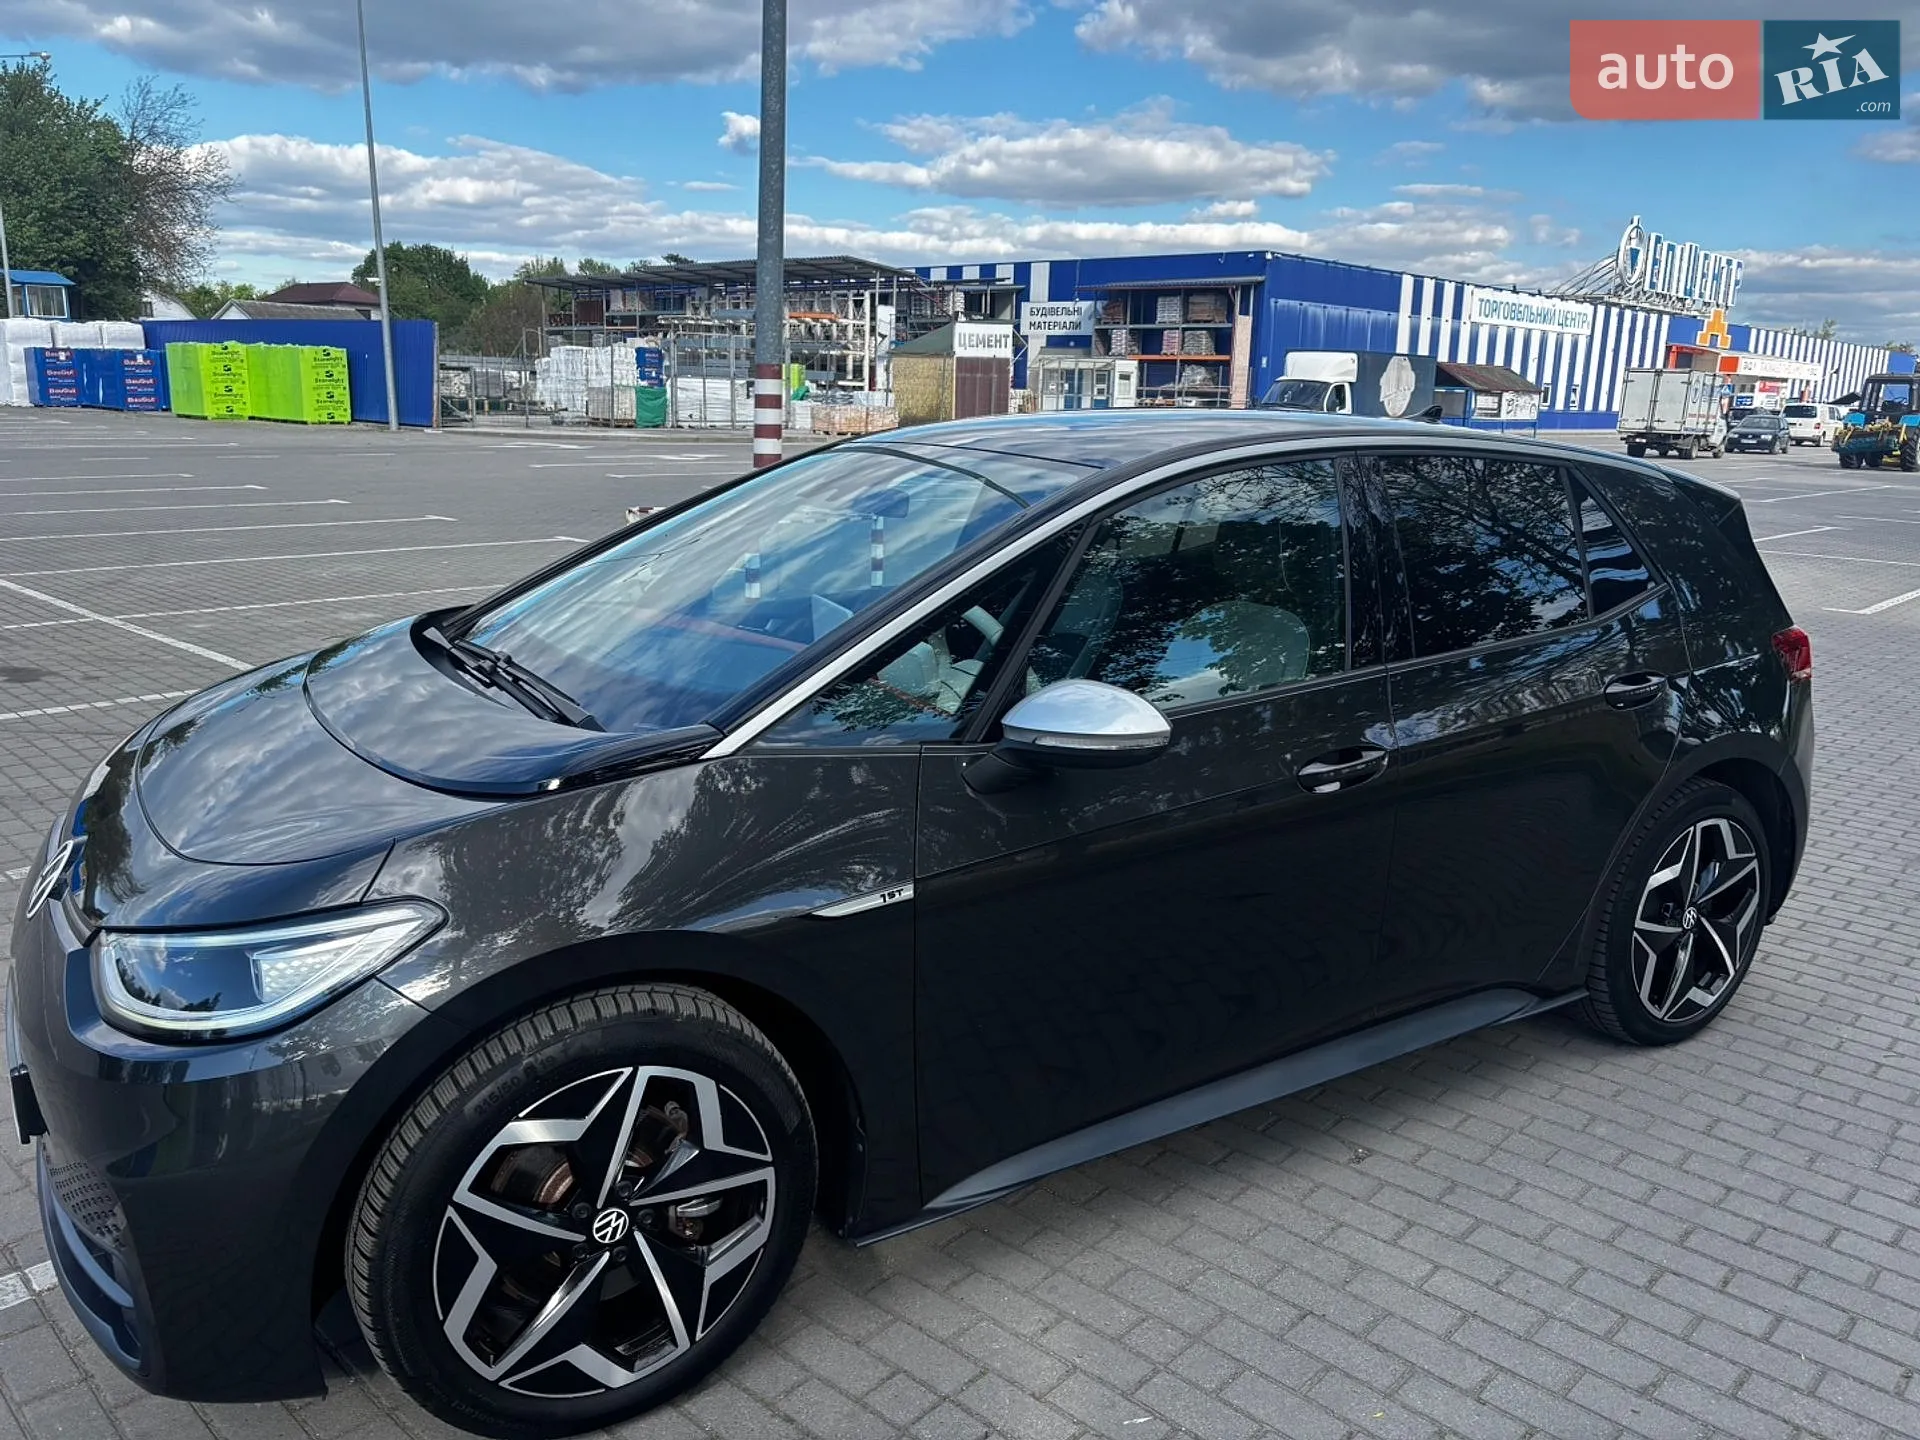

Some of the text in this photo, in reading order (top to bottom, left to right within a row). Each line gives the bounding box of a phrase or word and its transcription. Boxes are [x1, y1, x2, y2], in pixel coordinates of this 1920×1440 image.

[1029, 306, 1083, 318] БУДІВЕЛЬНІ
[1477, 297, 1588, 330] ТОРГОВЕЛЬНИЙ ЦЕНТР
[1029, 319, 1082, 331] МАТЕРІАЛИ
[957, 332, 1010, 351] ЦЕМЕНТ
